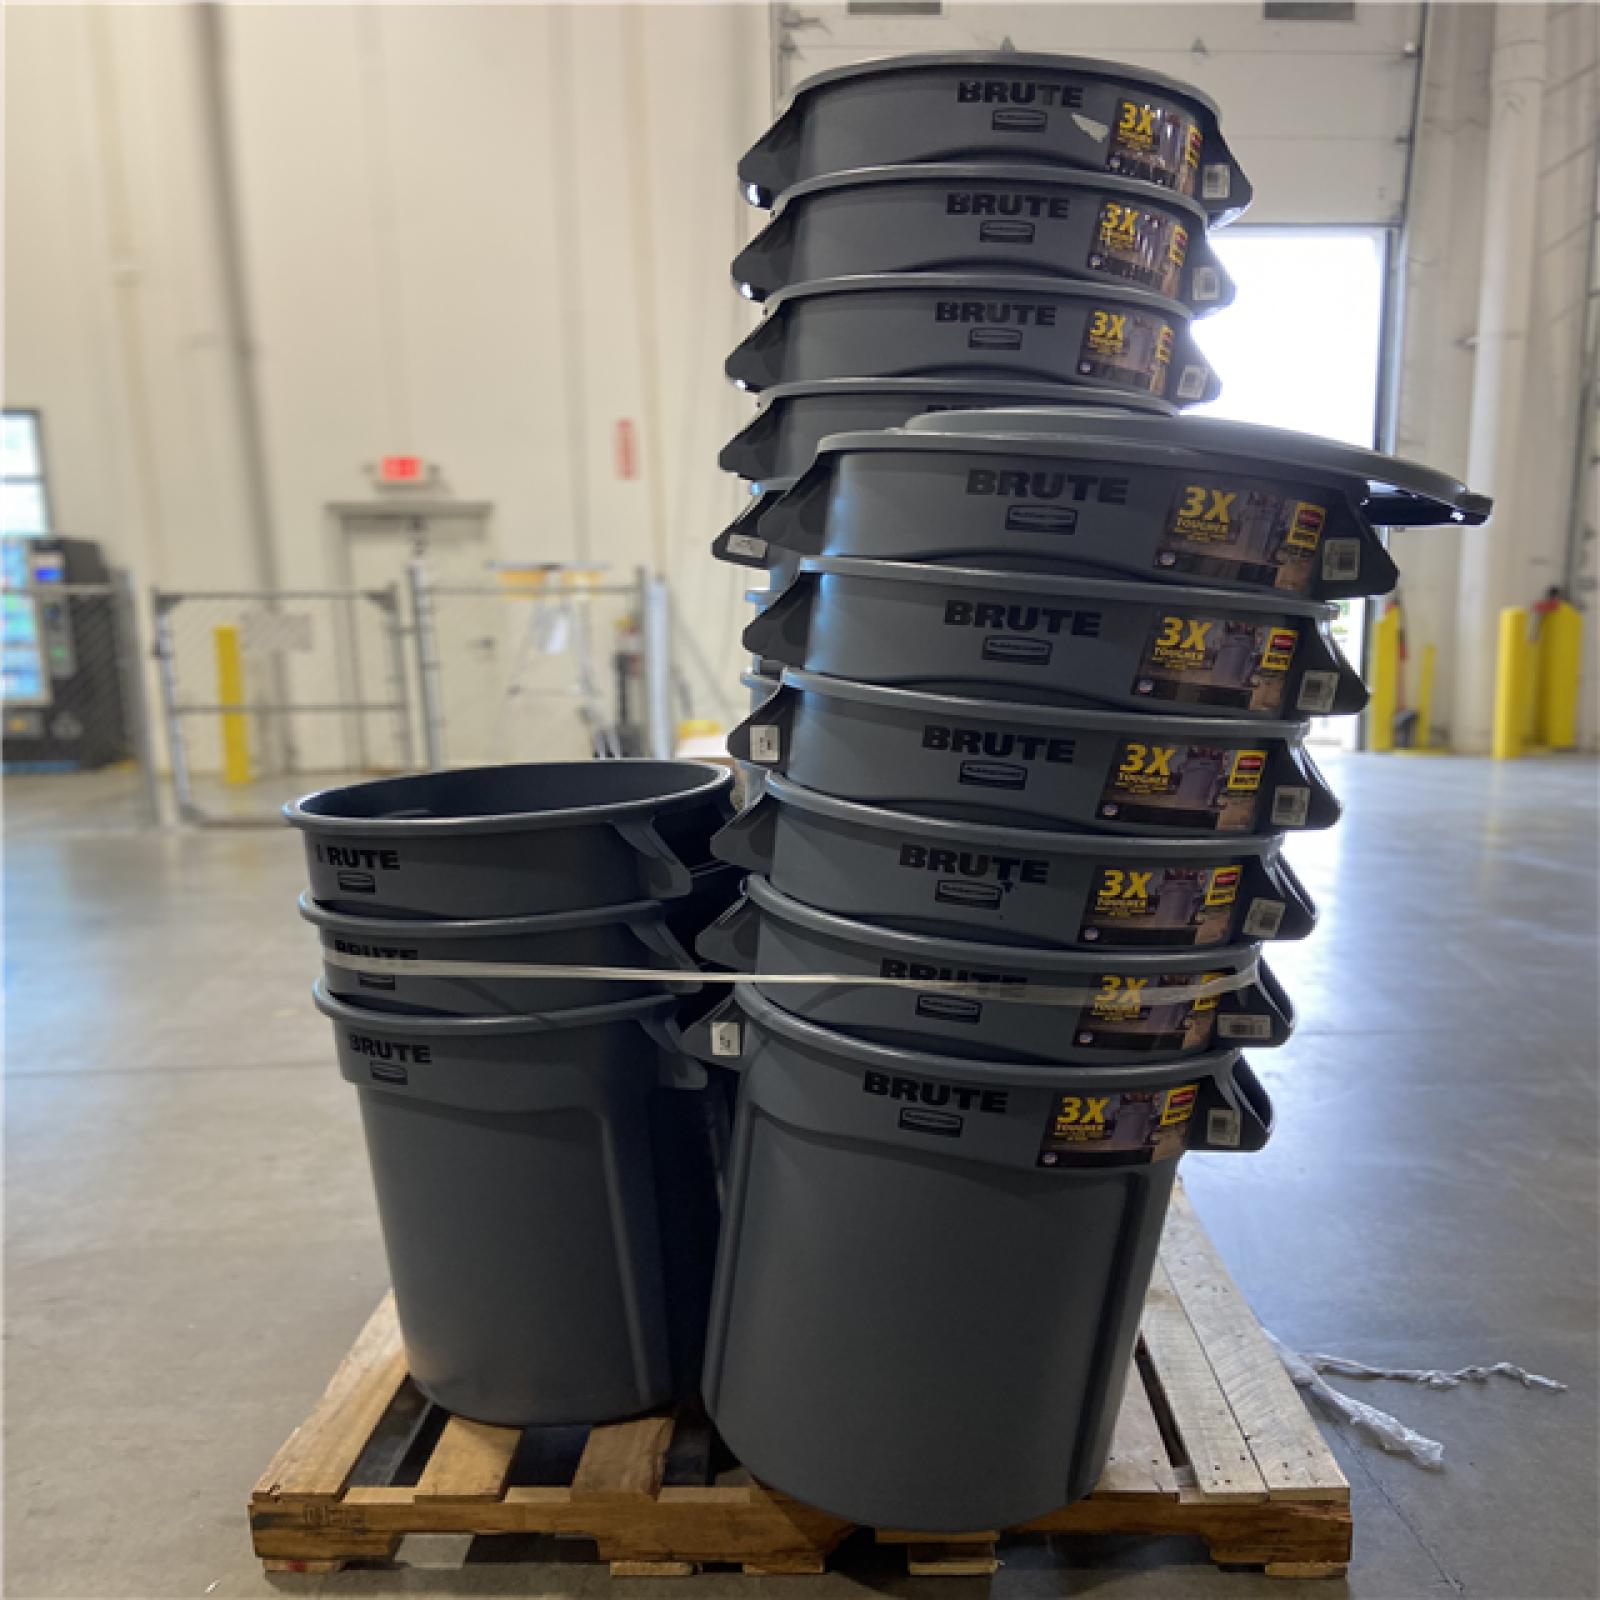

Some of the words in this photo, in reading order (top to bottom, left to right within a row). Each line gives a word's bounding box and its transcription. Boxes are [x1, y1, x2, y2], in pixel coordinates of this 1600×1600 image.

[957, 81, 1083, 108] BRUTE
[1119, 102, 1156, 135] 3X
[946, 193, 1071, 218] BRUTE
[1102, 201, 1139, 234] 3X
[934, 301, 1057, 326] BRUTE
[1090, 311, 1127, 340] 3X
[966, 467, 1130, 505] BRUTE
[1179, 485, 1236, 523] 3X
[944, 600, 1102, 638] BRUTE
[1156, 616, 1213, 651] 3X
[921, 724, 1076, 764] BRUTE
[1119, 743, 1176, 776] 3X
[899, 843, 1049, 884] BRUTE
[1098, 869, 1152, 899] 3X
[1095, 975, 1149, 1005] 3X
[863, 1070, 1009, 1114] BRUTE
[1056, 1096, 1111, 1124] 3X
